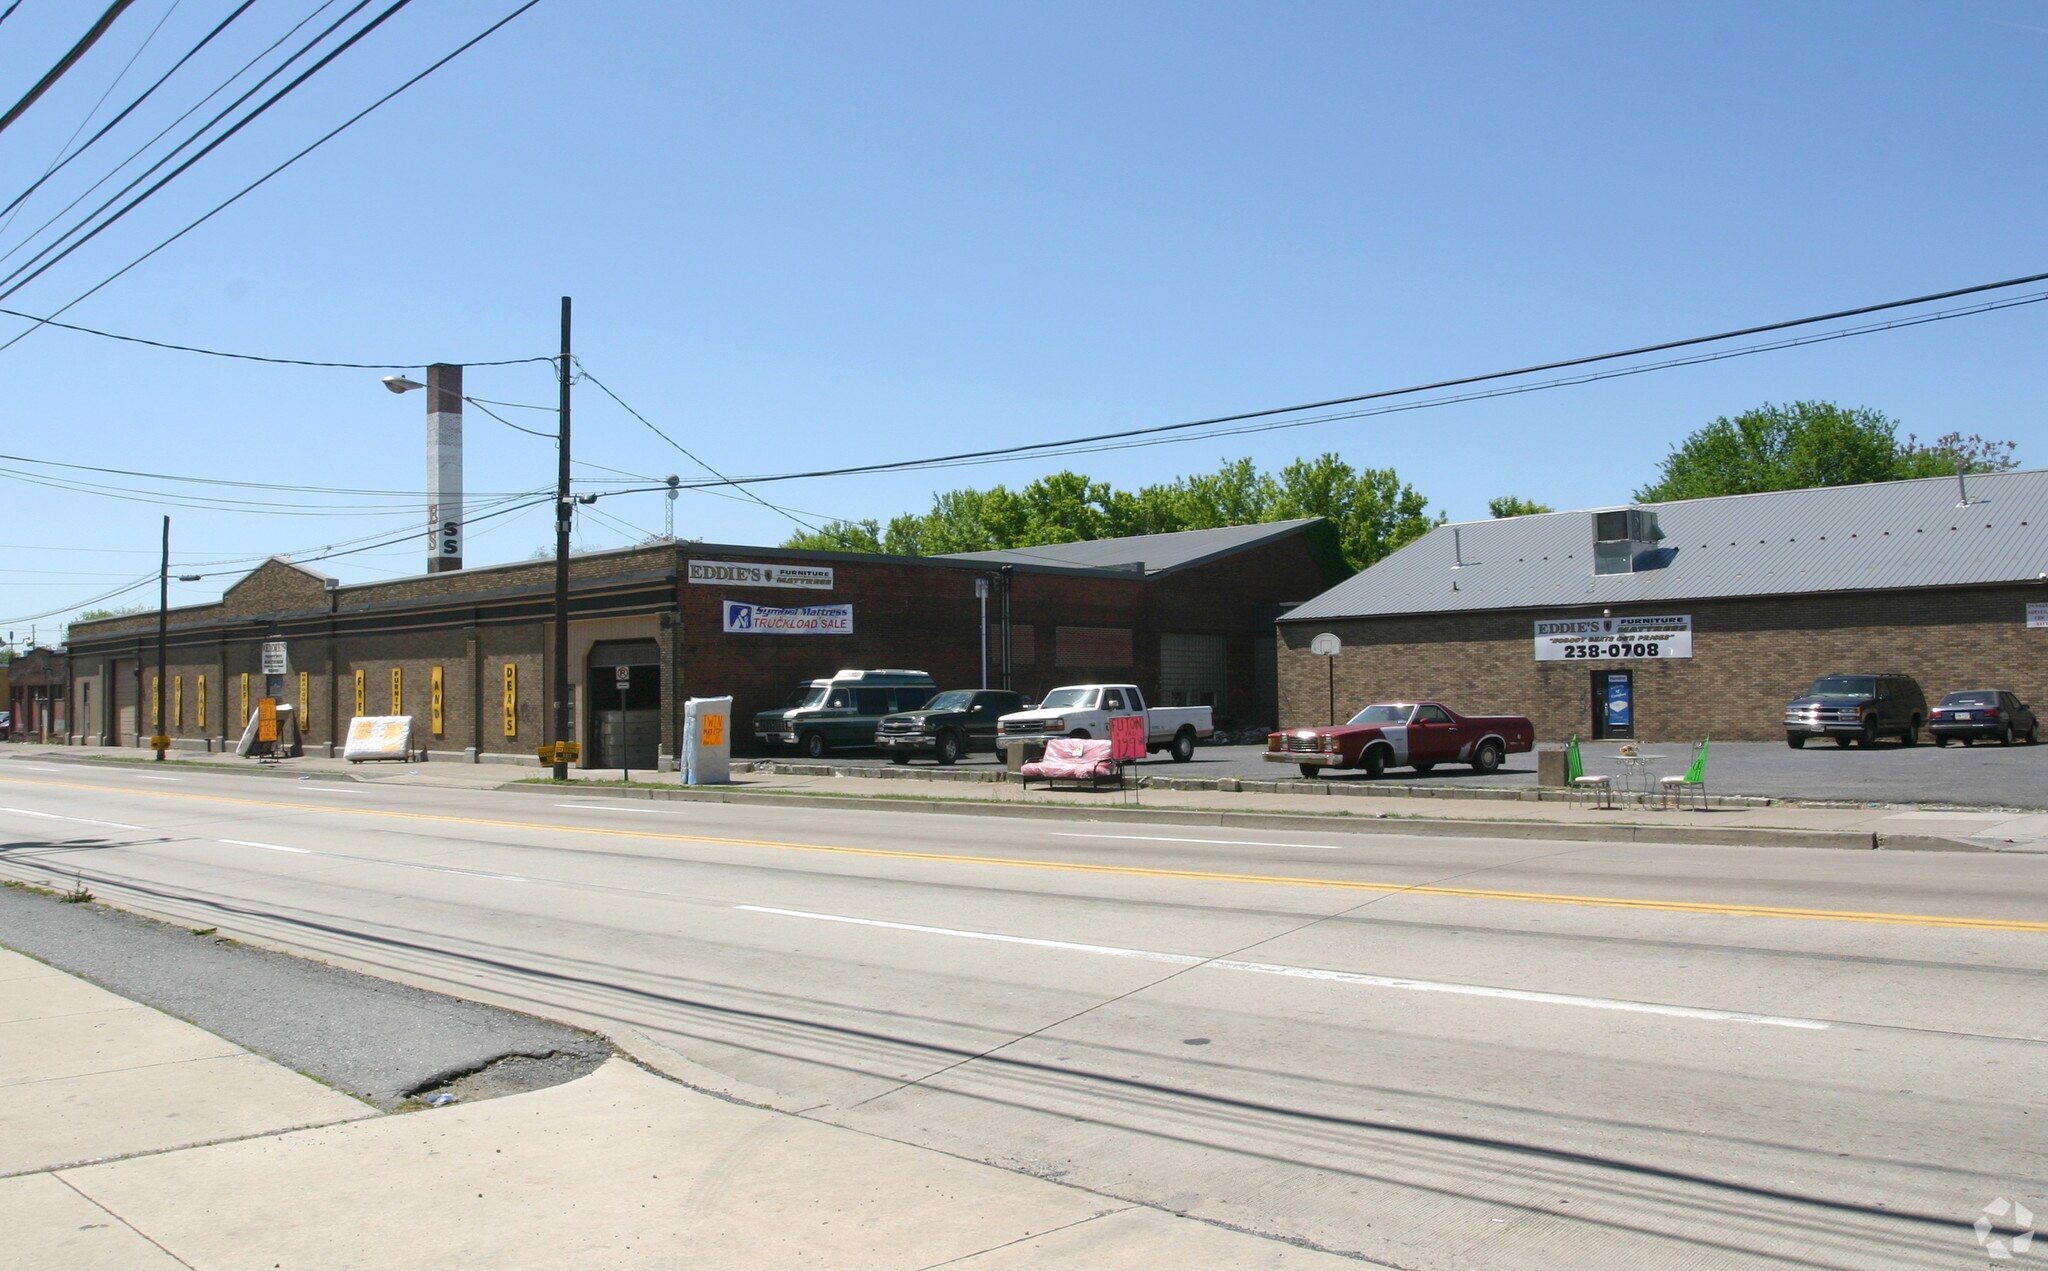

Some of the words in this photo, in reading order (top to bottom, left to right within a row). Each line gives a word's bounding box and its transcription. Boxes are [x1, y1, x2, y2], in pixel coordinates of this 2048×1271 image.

[690, 564, 761, 582] EDDIE'S
[780, 569, 830, 577] FURNITURE
[753, 618, 818, 628] TRUCKLOAD
[821, 619, 847, 629] SALE
[1620, 617, 1684, 625] FURNITURE
[1537, 621, 1600, 635] EDDIE'S
[1564, 643, 1659, 659] 238-0708
[1111, 718, 1142, 731] FUTON
